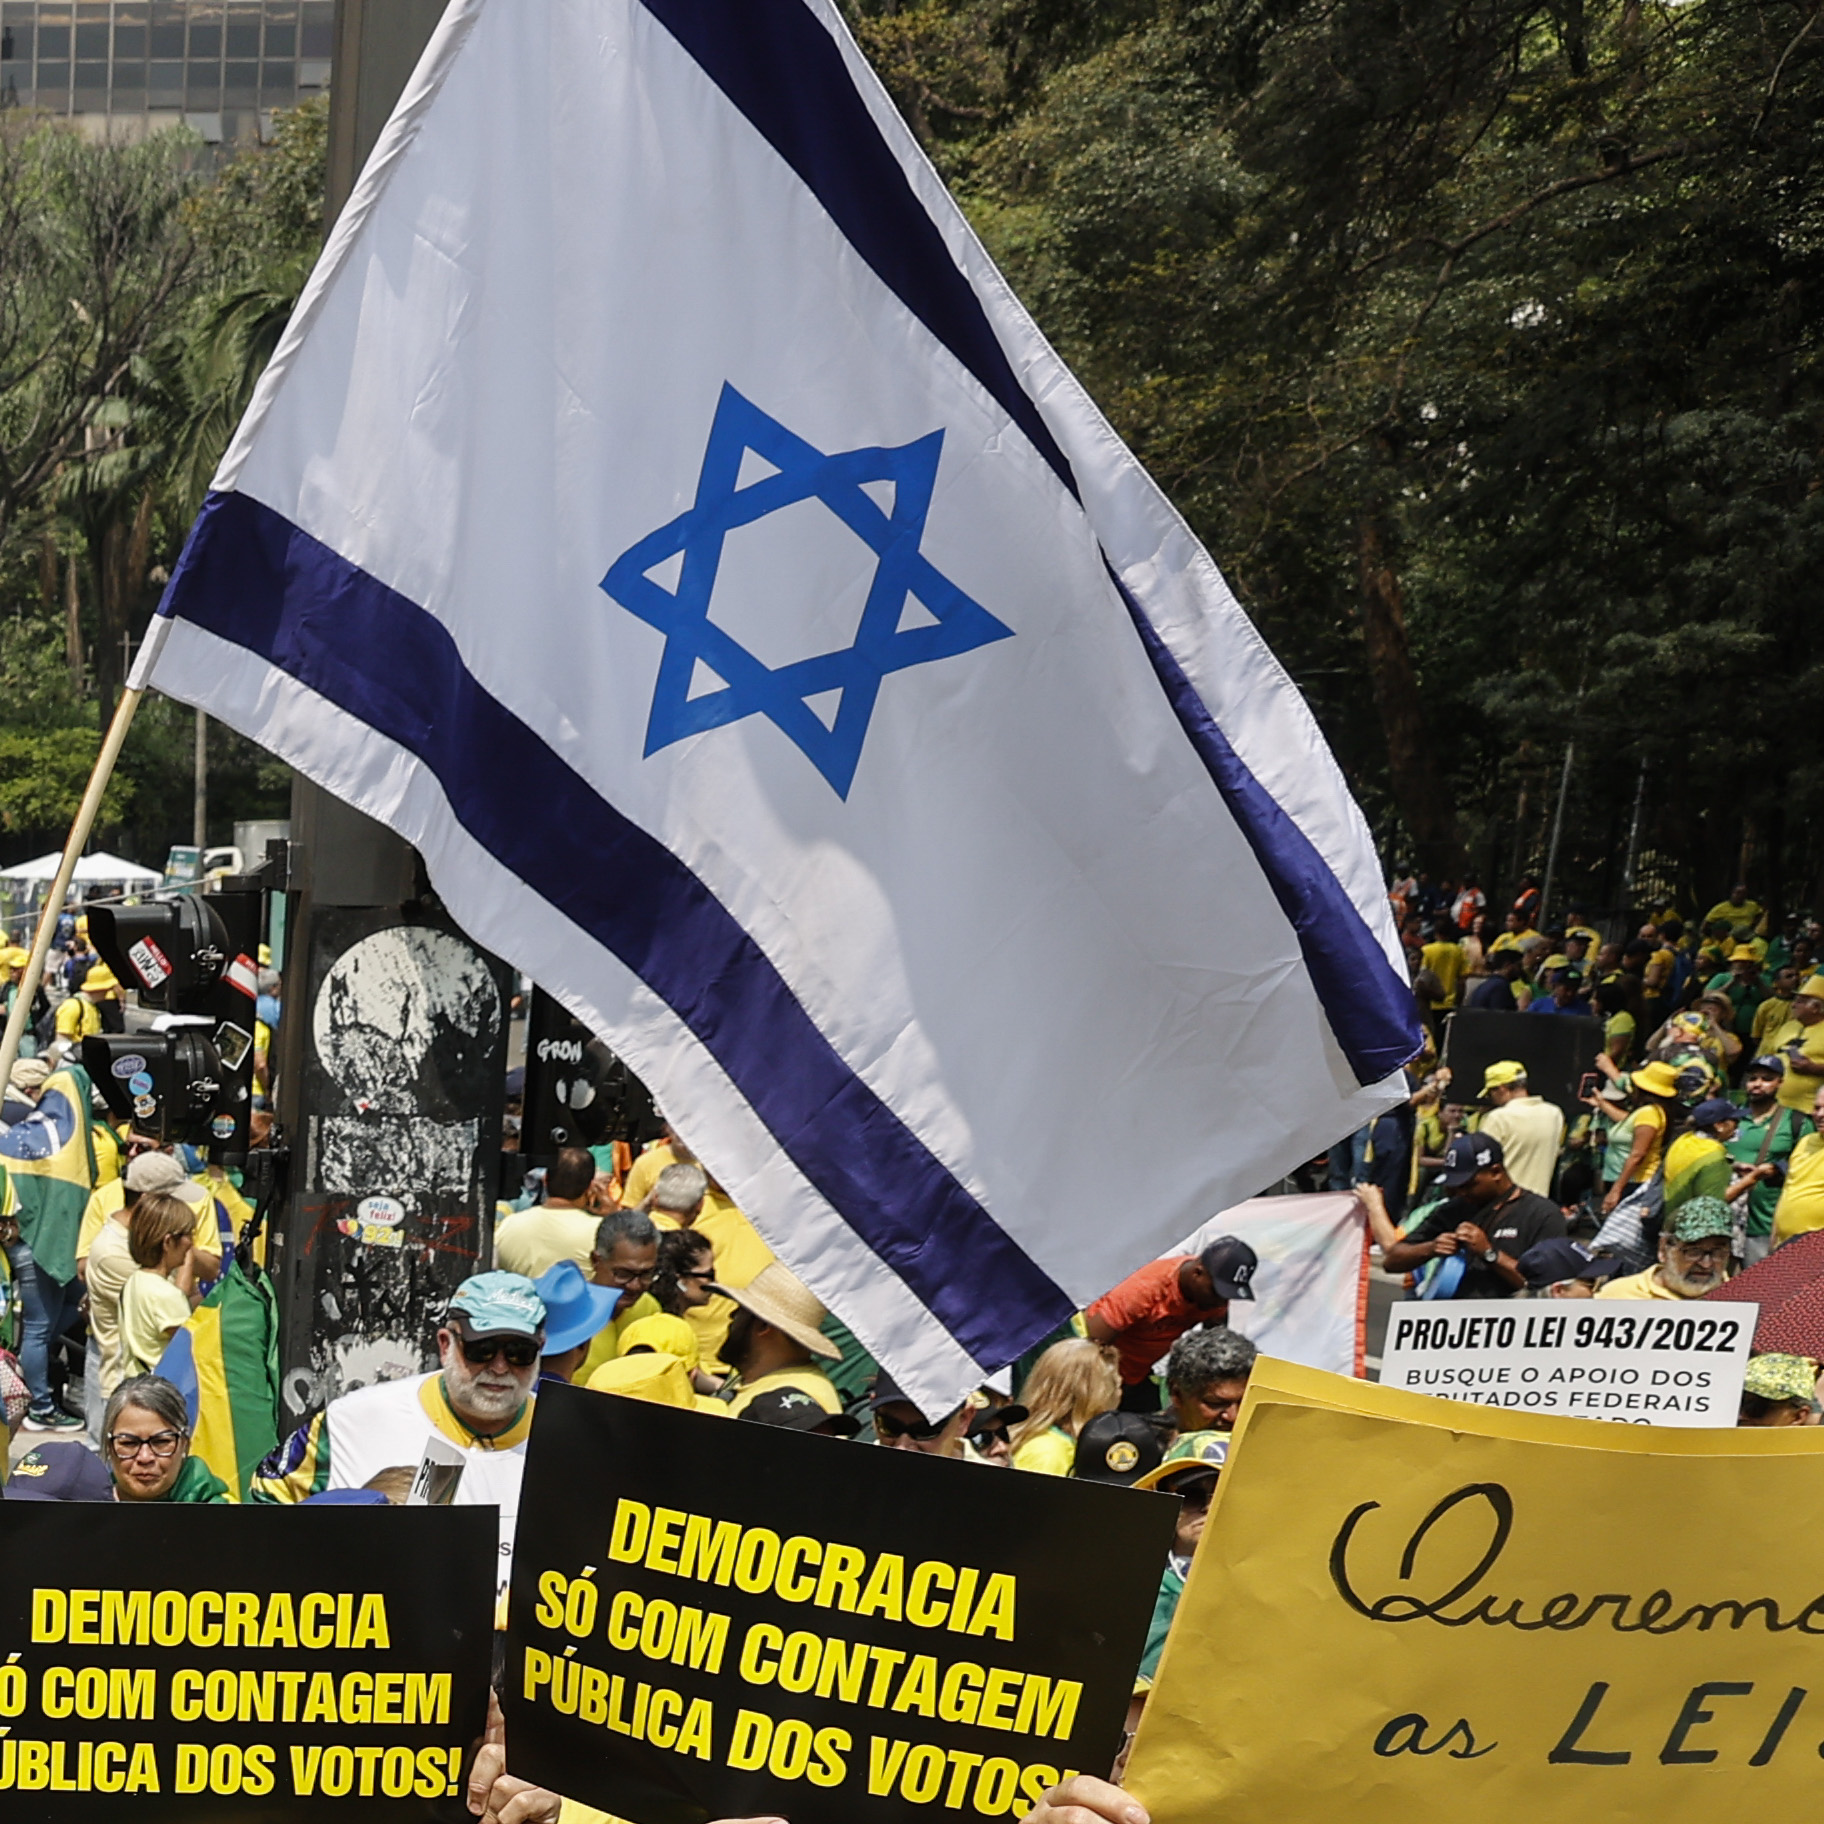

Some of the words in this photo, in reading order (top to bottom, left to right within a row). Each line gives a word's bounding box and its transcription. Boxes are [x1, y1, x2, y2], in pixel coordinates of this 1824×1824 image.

[1394, 1317, 1516, 1350] PROJETO
[1523, 1316, 1567, 1349] LEI
[1574, 1316, 1740, 1353] 943/2022
[1406, 1368, 1511, 1386] BUSQUE
[1521, 1368, 1539, 1383] O
[1549, 1368, 1639, 1385] APOIO
[1651, 1370, 1712, 1388] DOS
[1569, 1392, 1710, 1412] FEDERAIS
[607, 1496, 1017, 1642] DEMOCRACIA
[30, 1586, 390, 1651] DEMOCRACIA
[535, 1564, 598, 1638] SÓ
[607, 1591, 731, 1675] COM
[738, 1622, 1084, 1741] CONTAGEM
[39, 1667, 156, 1725] COM
[170, 1670, 454, 1726] CONTAGEM
[522, 1643, 714, 1761] PÚBLICA
[726, 1707, 853, 1789] DOS
[1547, 1681, 1824, 1767] LEI
[174, 1742, 276, 1797] DOS
[289, 1745, 463, 1799] VOTOS!
